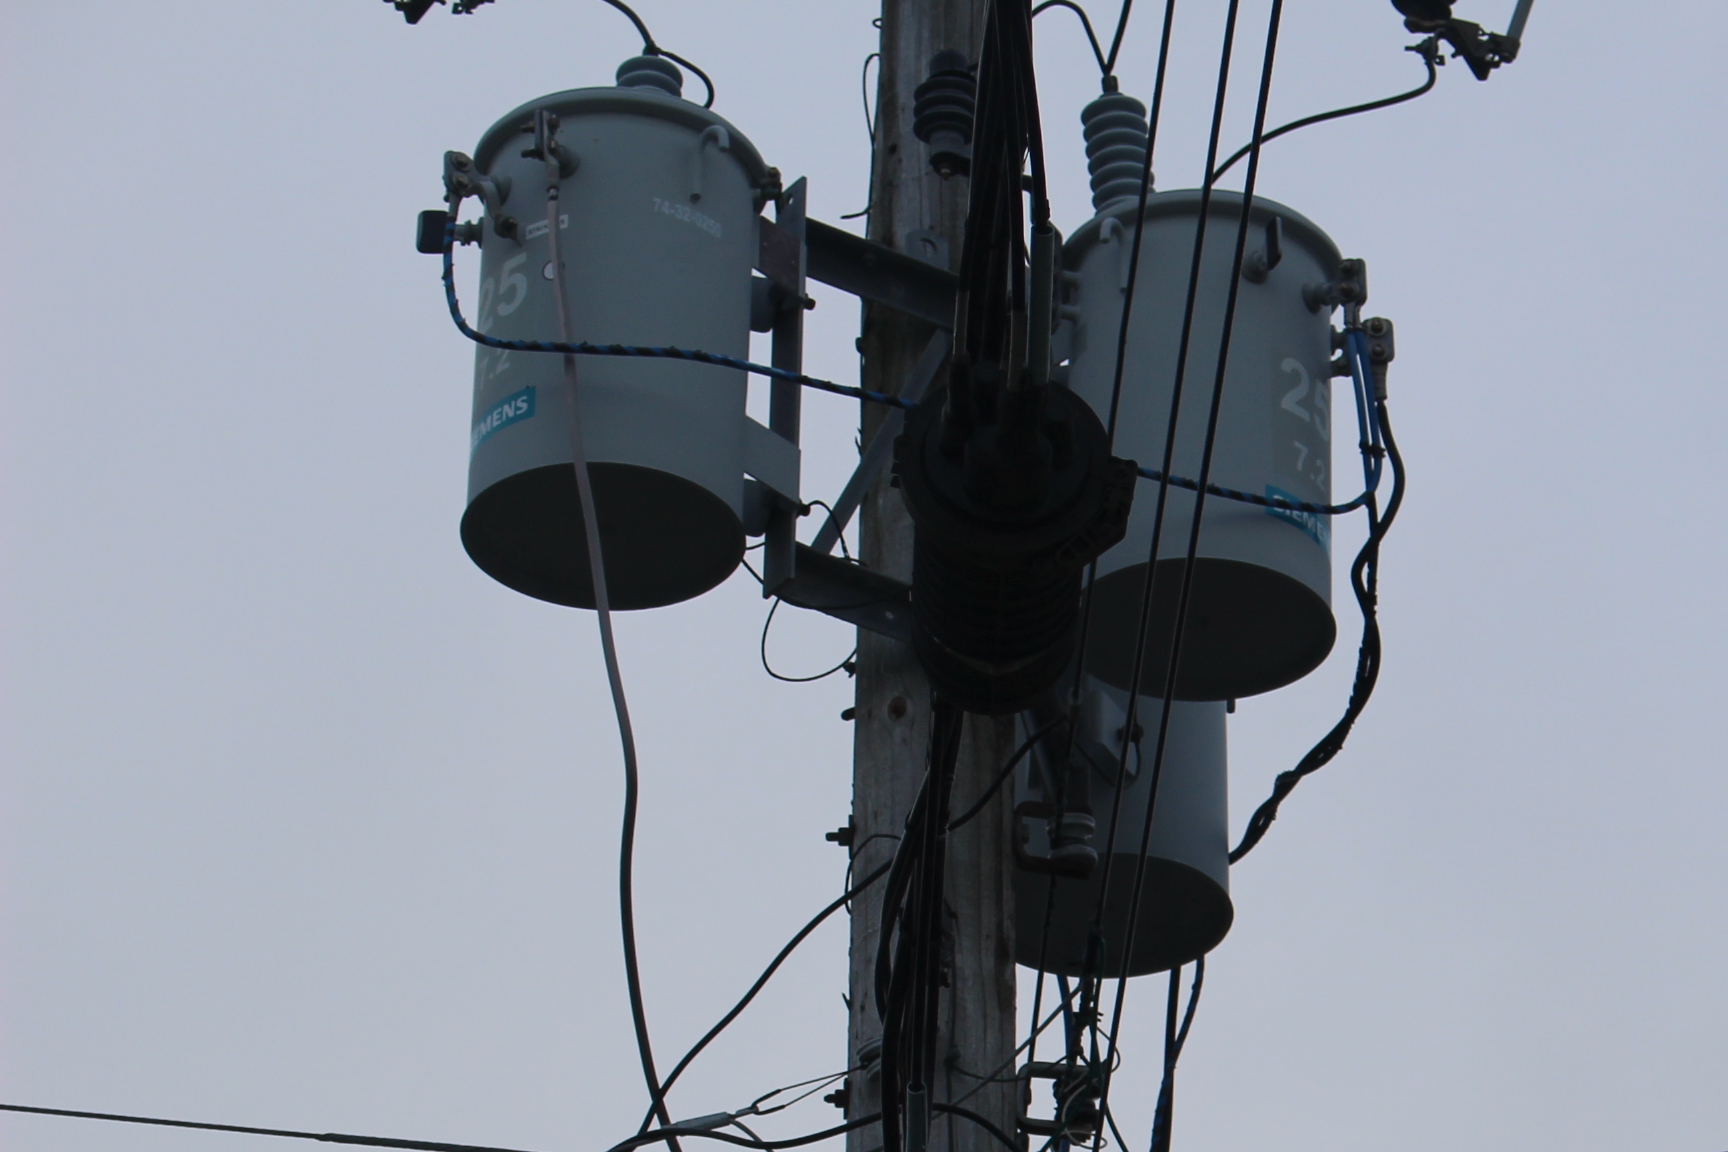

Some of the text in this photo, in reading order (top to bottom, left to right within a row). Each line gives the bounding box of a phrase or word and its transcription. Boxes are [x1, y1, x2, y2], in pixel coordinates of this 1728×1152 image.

[478, 252, 528, 335] 25
[1280, 357, 1329, 442] 25
[1293, 440, 1326, 492] 7.2
